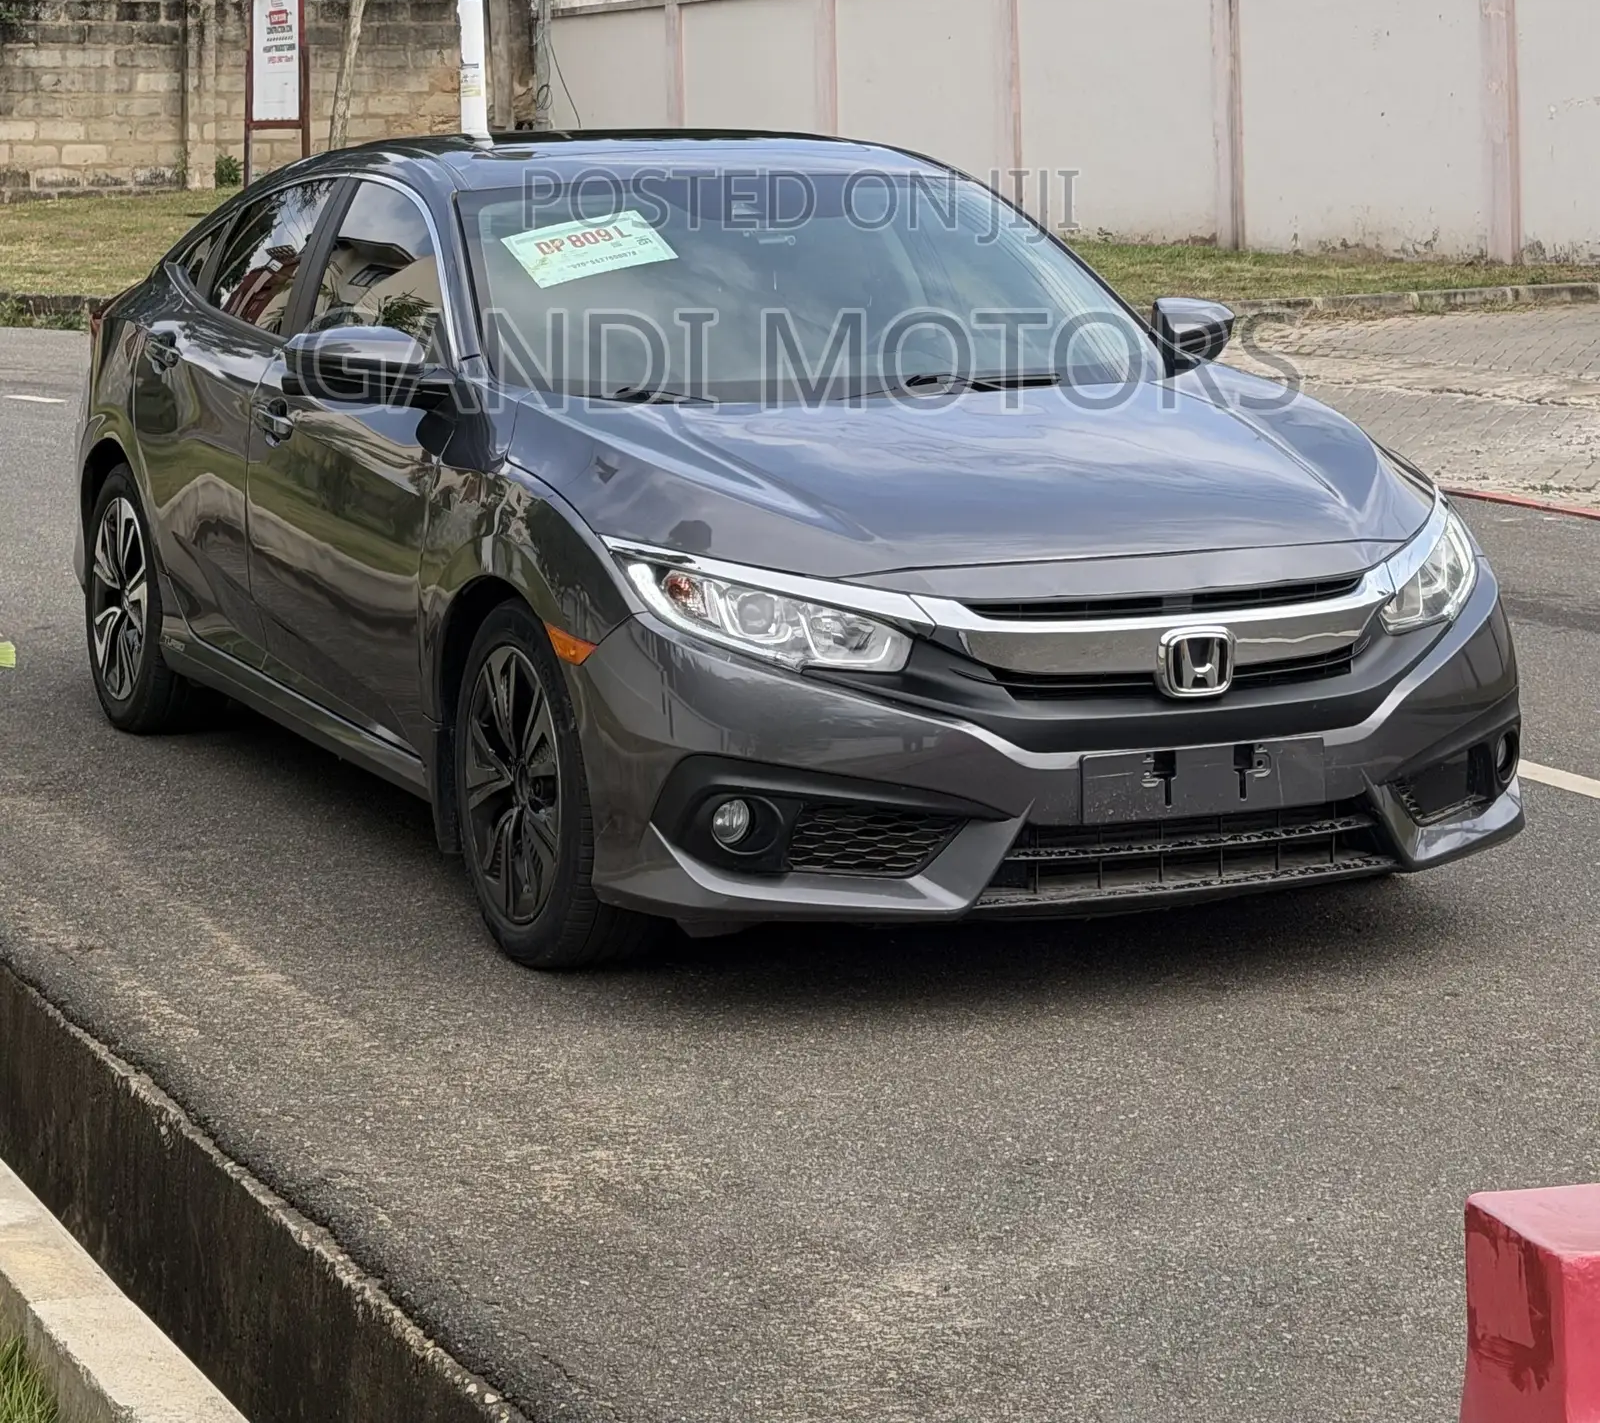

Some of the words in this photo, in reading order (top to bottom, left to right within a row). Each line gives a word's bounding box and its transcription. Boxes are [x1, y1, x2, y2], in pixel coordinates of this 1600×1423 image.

[534, 238, 565, 256] DP
[567, 227, 614, 248] 809
[613, 225, 633, 239] L
